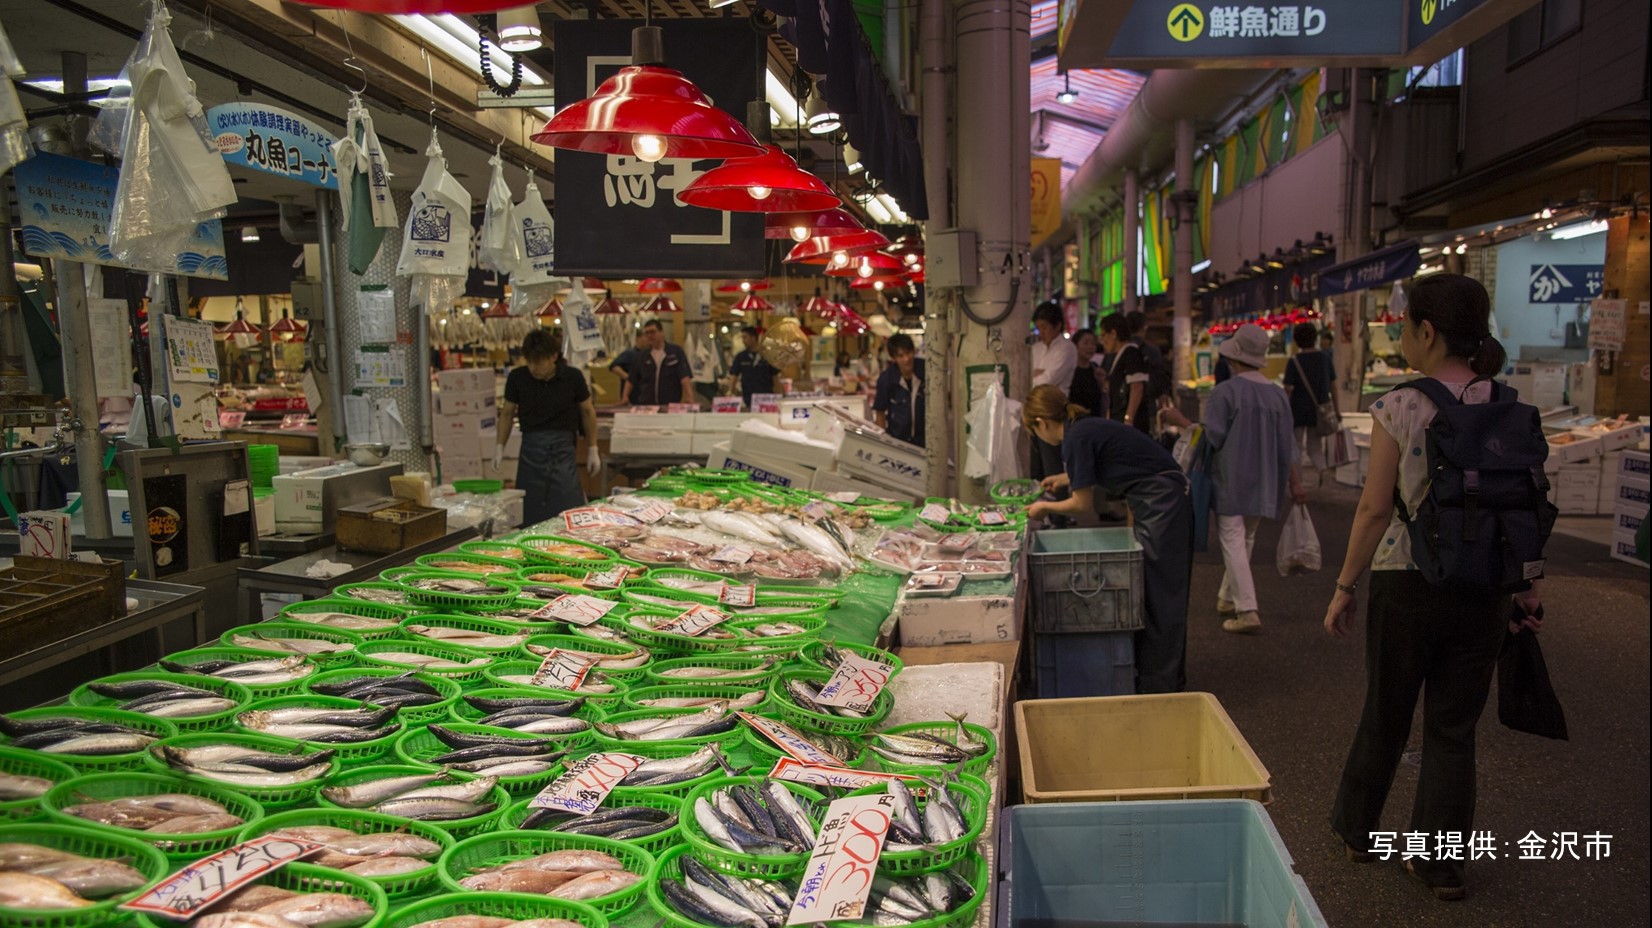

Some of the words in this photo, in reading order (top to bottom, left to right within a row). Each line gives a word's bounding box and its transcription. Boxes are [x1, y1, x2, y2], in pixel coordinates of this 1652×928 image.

[1209, 6, 1326, 38] 鮮魚通り
[1533, 276, 1560, 301] か
[1586, 280, 1604, 294] ヤ
[996, 624, 1009, 639] 5
[835, 661, 858, 682] アジ
[842, 668, 887, 702] 350
[577, 754, 640, 791] 400
[813, 812, 850, 859] トビ魚
[825, 808, 890, 896] 300
[878, 795, 895, 807] 円
